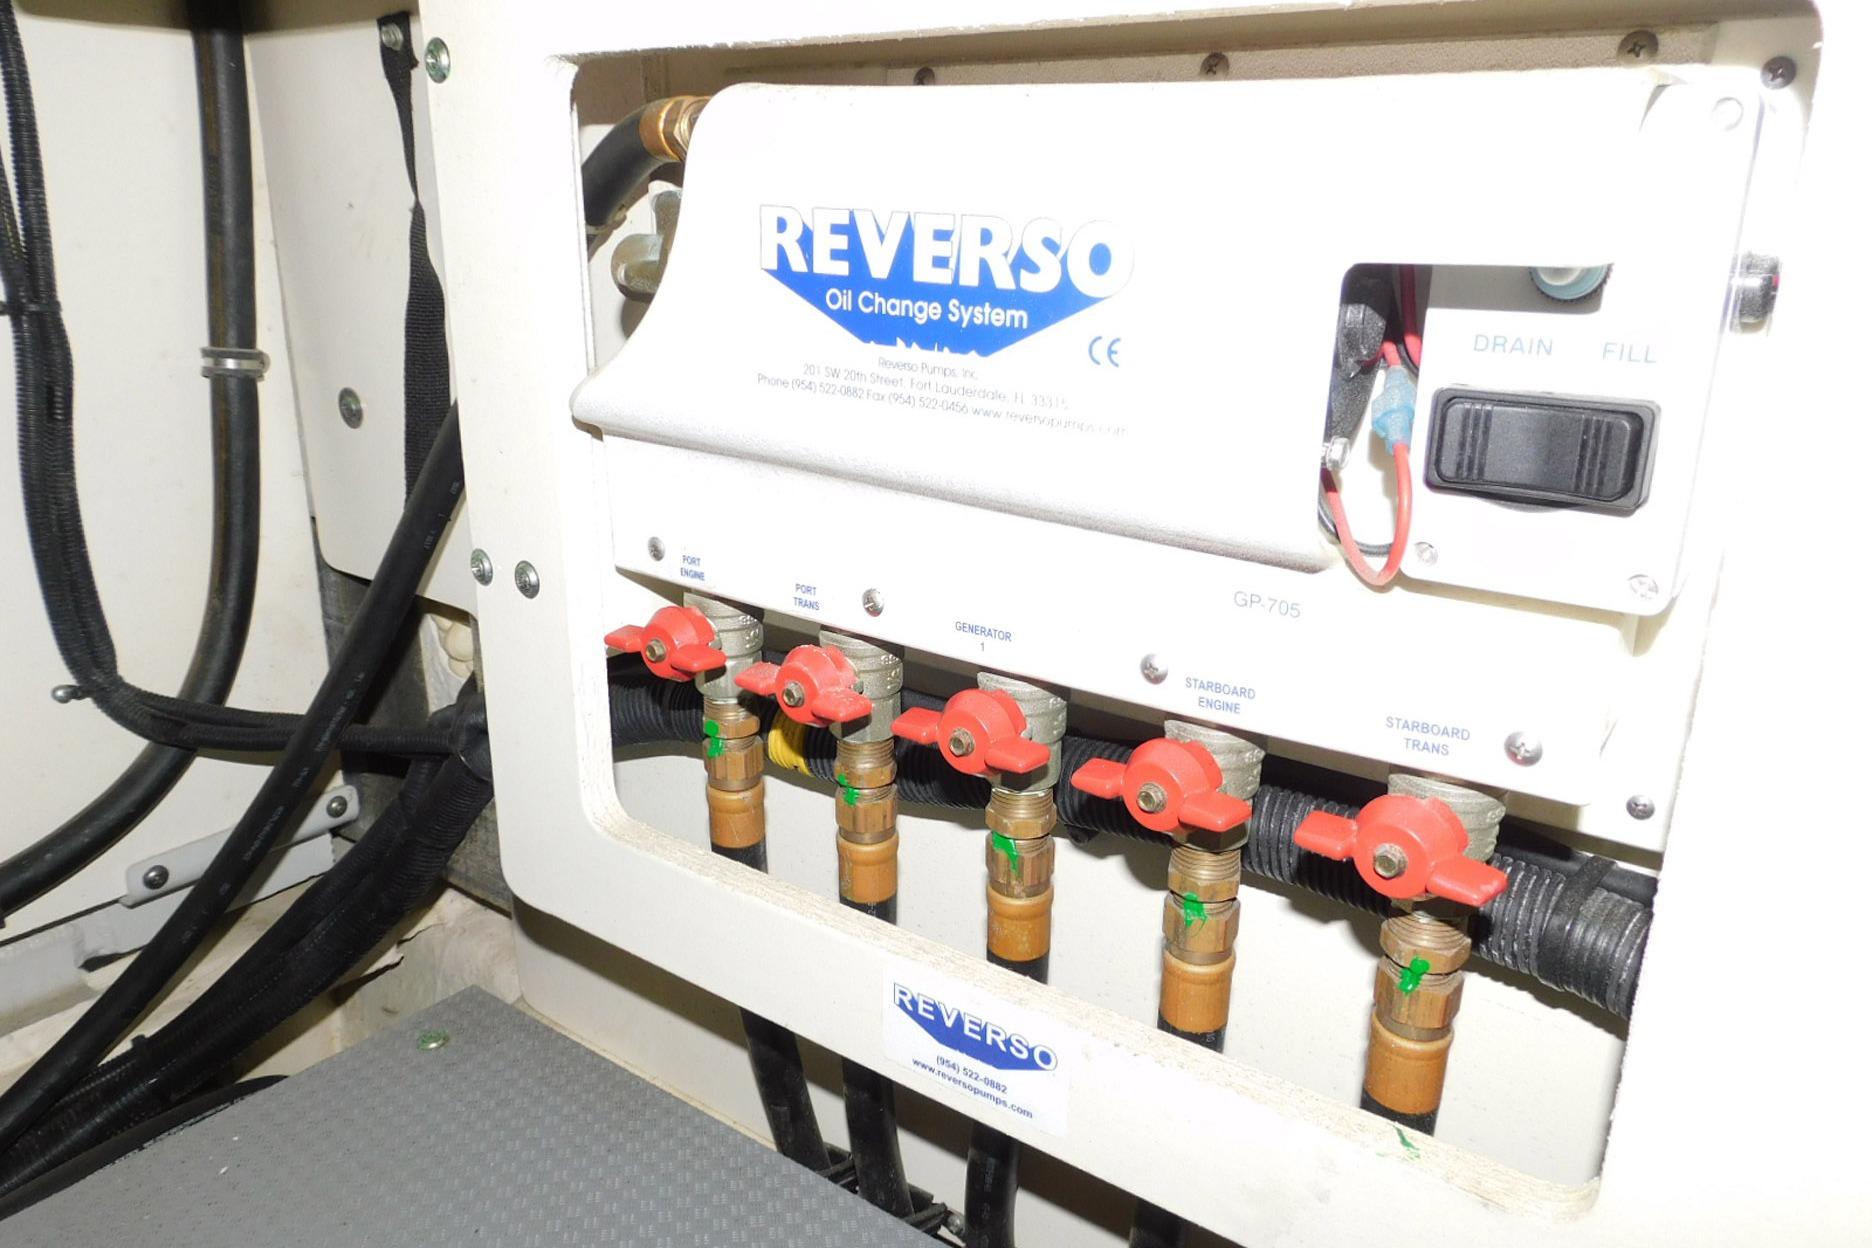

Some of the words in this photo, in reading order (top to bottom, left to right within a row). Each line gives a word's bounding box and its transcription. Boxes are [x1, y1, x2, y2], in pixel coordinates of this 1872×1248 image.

[760, 204, 1135, 299] REVERSO
[825, 287, 852, 311] Oil
[857, 290, 941, 325] Change
[948, 298, 1028, 330] System
[1088, 335, 1121, 368] CE
[1473, 333, 1553, 356] DRAIN
[1602, 341, 1657, 364] FILL
[878, 356, 918, 373] Reverso
[803, 362, 821, 376] 201
[824, 366, 841, 380] SW
[843, 368, 867, 383] 20th
[910, 377, 931, 392] Fort
[757, 373, 790, 389] Phone
[792, 377, 817, 394] (954)
[819, 382, 865, 399] 522-0882
[866, 389, 885, 402] Fax
[888, 392, 916, 409] (954)
[919, 396, 969, 416] 522-0456
[682, 555, 701, 568] PORT
[680, 567, 705, 582] ENGINE
[795, 583, 817, 596] PORT
[793, 596, 820, 612] TRANS
[1233, 590, 1302, 619] GP-705
[955, 620, 1012, 642] GENERATOR
[980, 642, 985, 652] 1
[1185, 676, 1256, 700] STARBOARD
[1198, 696, 1241, 715] ENGINE
[1386, 716, 1471, 741] STARBOARD
[1404, 737, 1450, 757] TRANS
[893, 982, 1058, 1071] REVERSO
[936, 1055, 960, 1075] (954)
[962, 1065, 1008, 1095] 522-0882
[912, 1058, 1033, 1119] www.reversopumps.com
